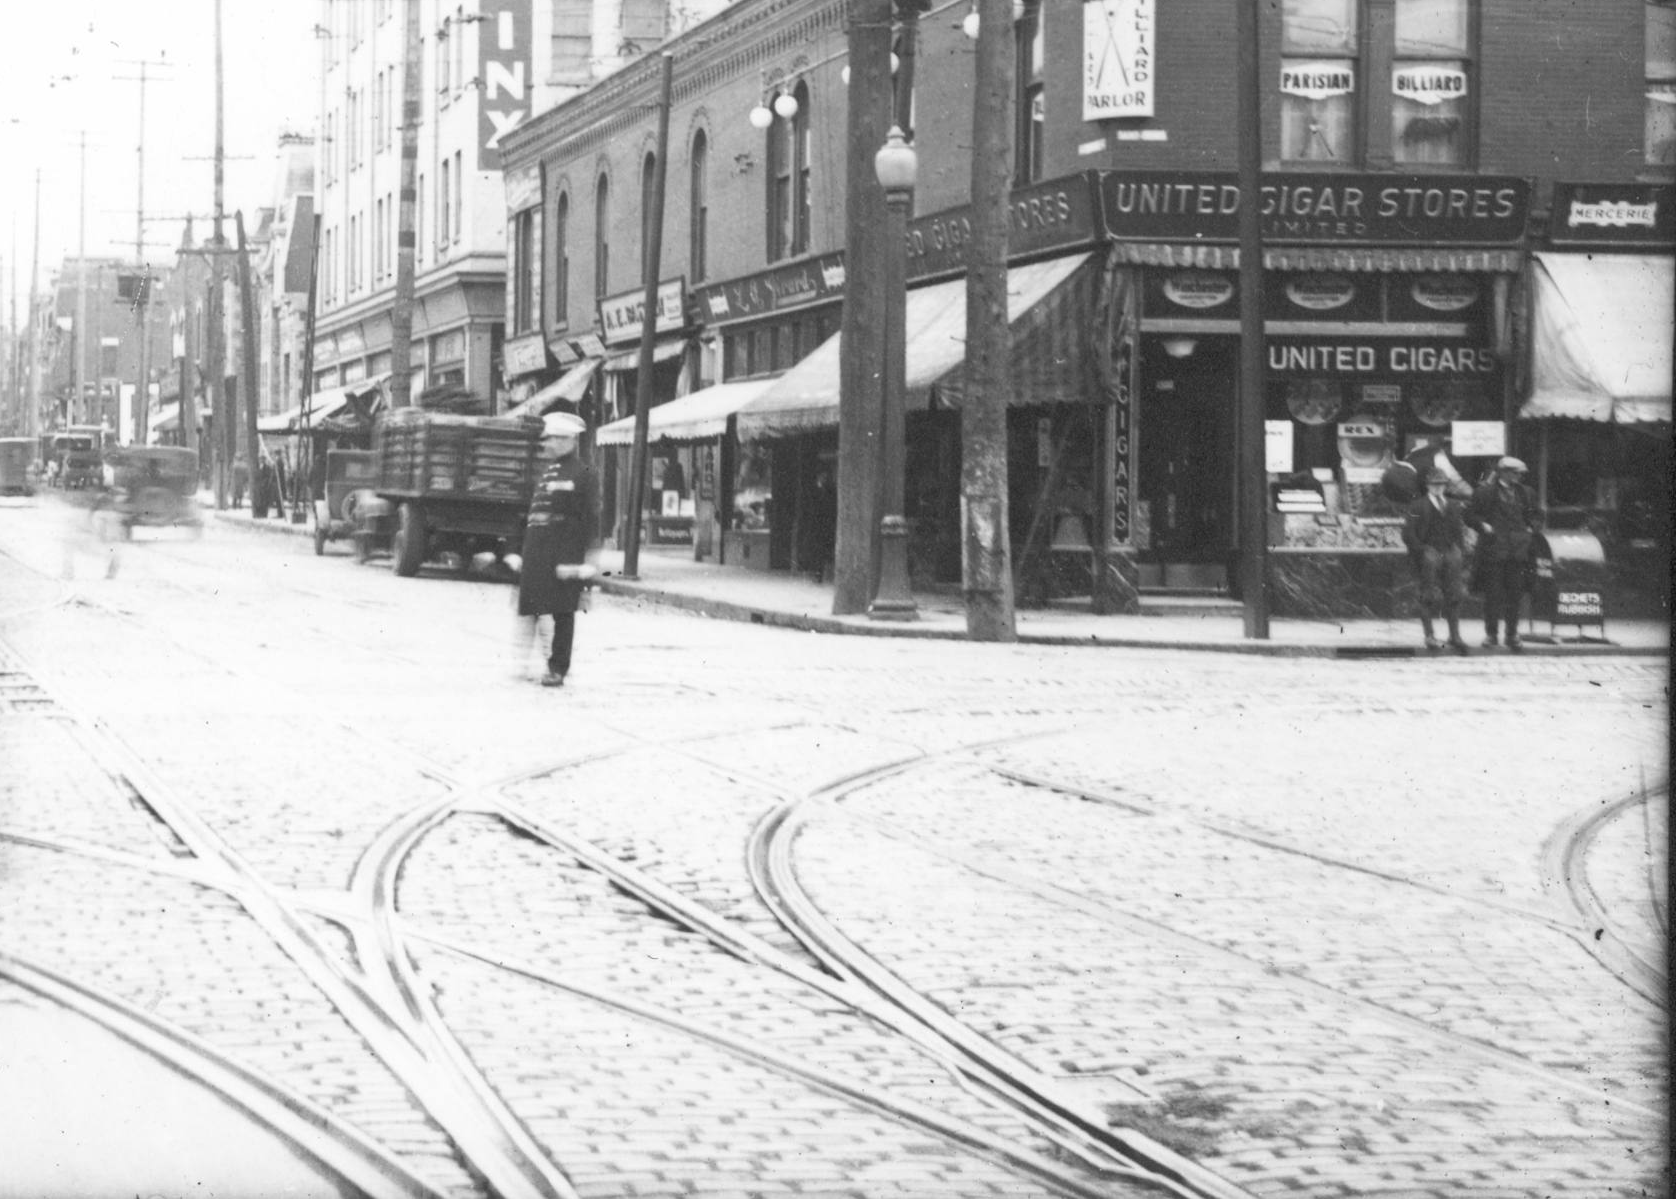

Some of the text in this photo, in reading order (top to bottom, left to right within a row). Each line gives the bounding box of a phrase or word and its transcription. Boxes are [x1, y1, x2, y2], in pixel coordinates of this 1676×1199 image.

[1282, 72, 1351, 90] PARISIAN
[1396, 74, 1463, 93] BILLIARD
[1087, 91, 1146, 109] PARLOR
[1117, 183, 1241, 215] UNITED
[1378, 187, 1516, 218] STORES
[1575, 208, 1652, 220] MERCERIE
[1269, 346, 1495, 372] UNITED CIGARS
[1344, 425, 1375, 435] REX
[1115, 385, 1129, 531] CIGARS
